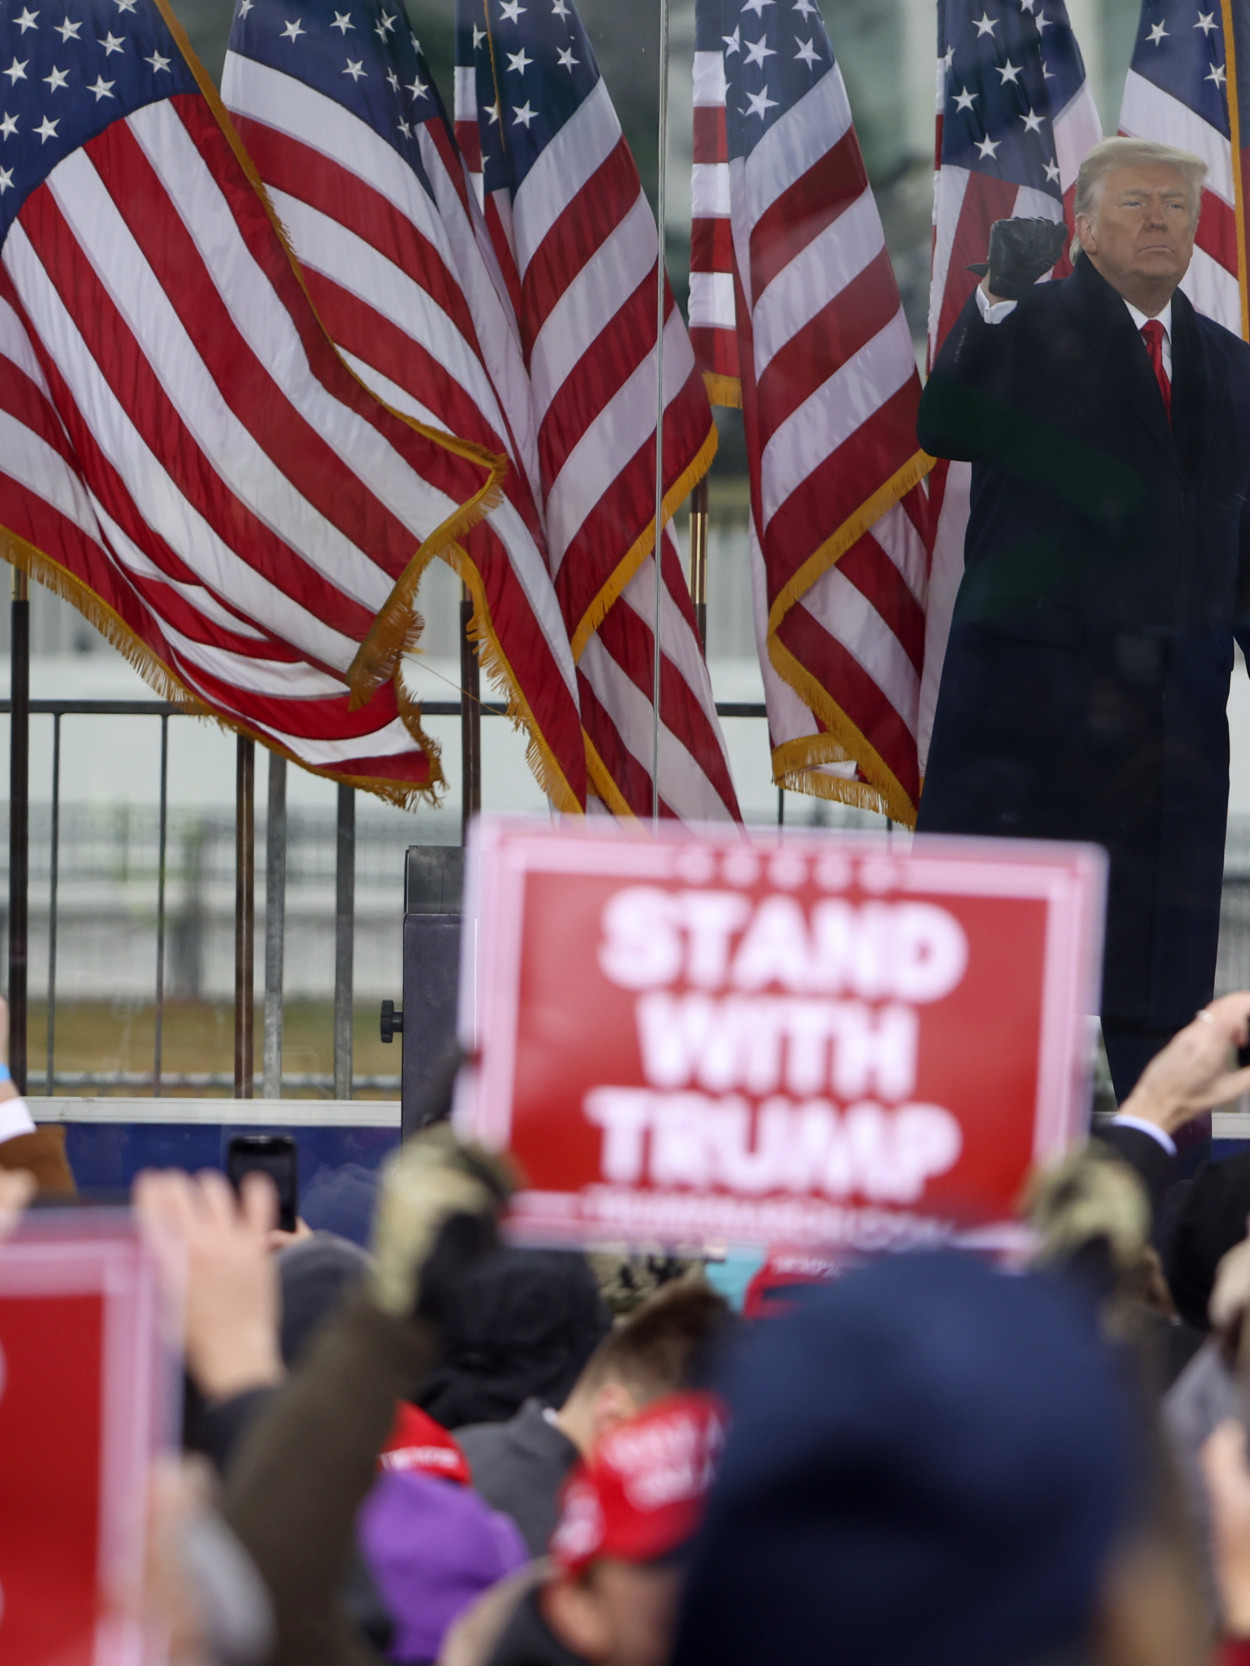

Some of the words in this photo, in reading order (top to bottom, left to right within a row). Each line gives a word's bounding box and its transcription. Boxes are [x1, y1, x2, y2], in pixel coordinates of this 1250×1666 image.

[600, 886, 968, 1002] STAND
[637, 991, 917, 1098] WITH
[585, 1086, 961, 1203] TRUMP
